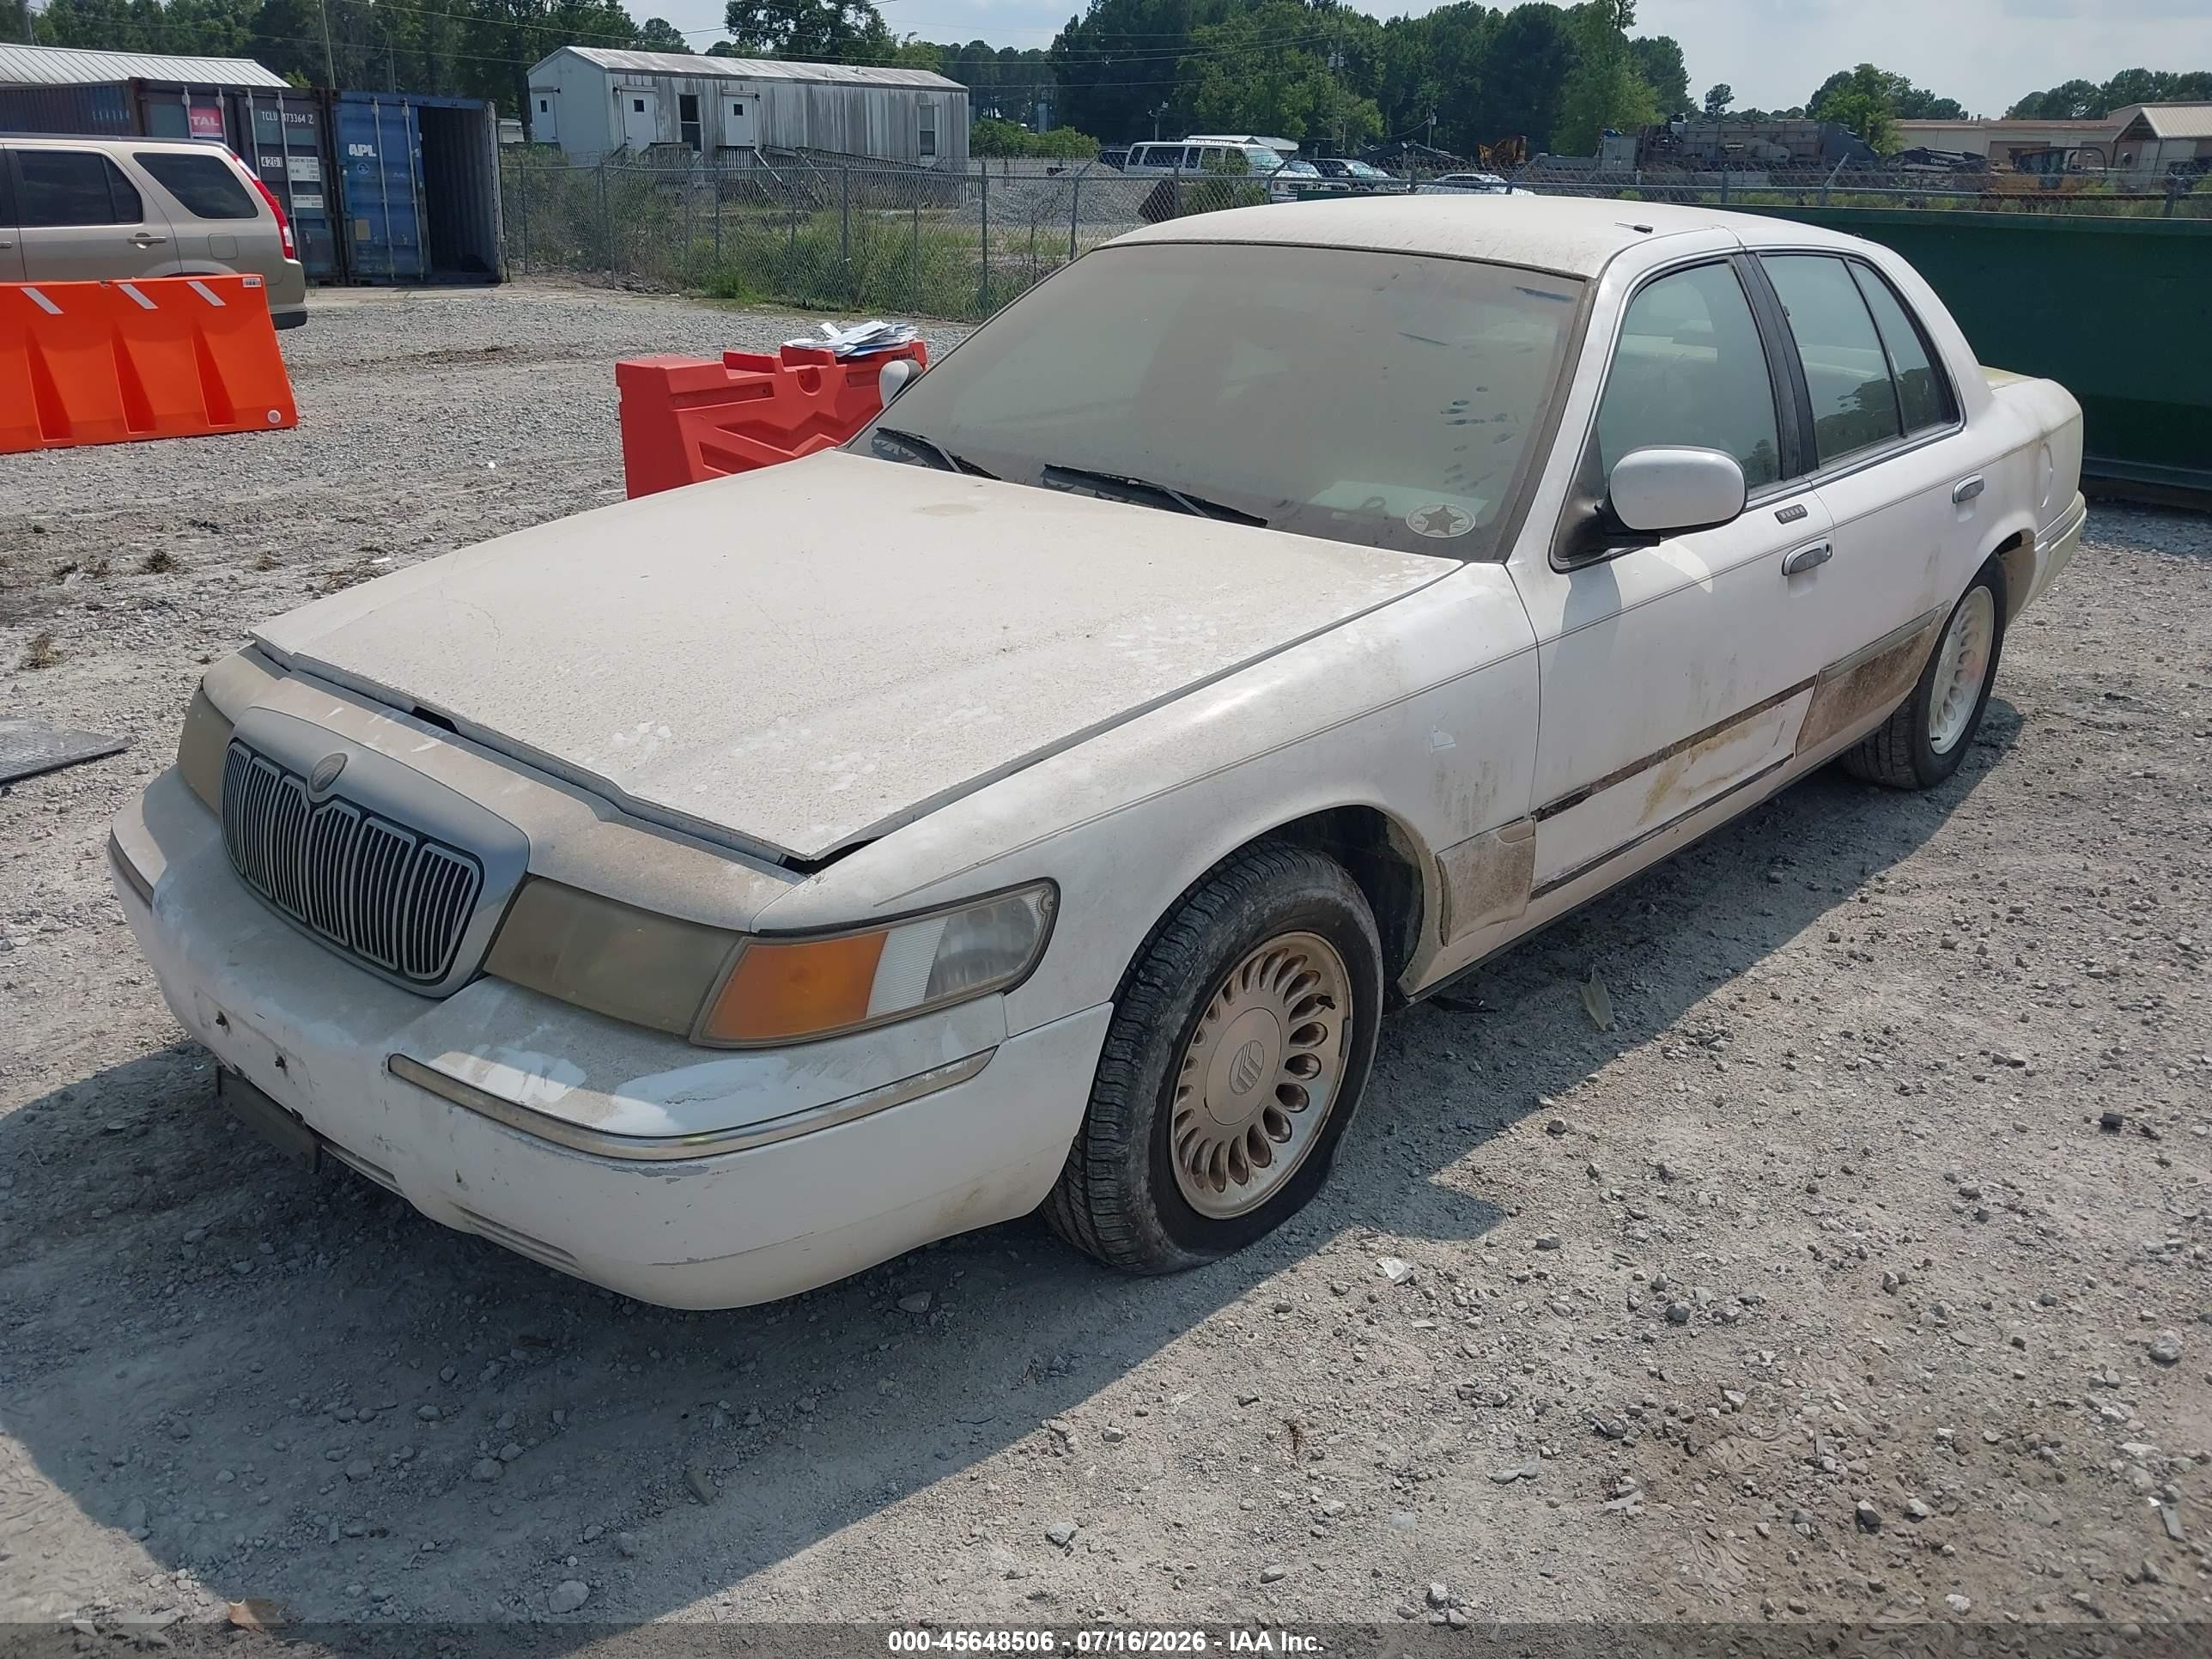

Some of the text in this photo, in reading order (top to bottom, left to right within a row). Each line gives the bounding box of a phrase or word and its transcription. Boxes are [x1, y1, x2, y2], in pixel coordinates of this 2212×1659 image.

[191, 116, 220, 126] TAL
[261, 111, 278, 121] TCLU
[308, 114, 314, 125] 2
[349, 143, 377, 157] APL
[262, 157, 282, 166] 42G1
